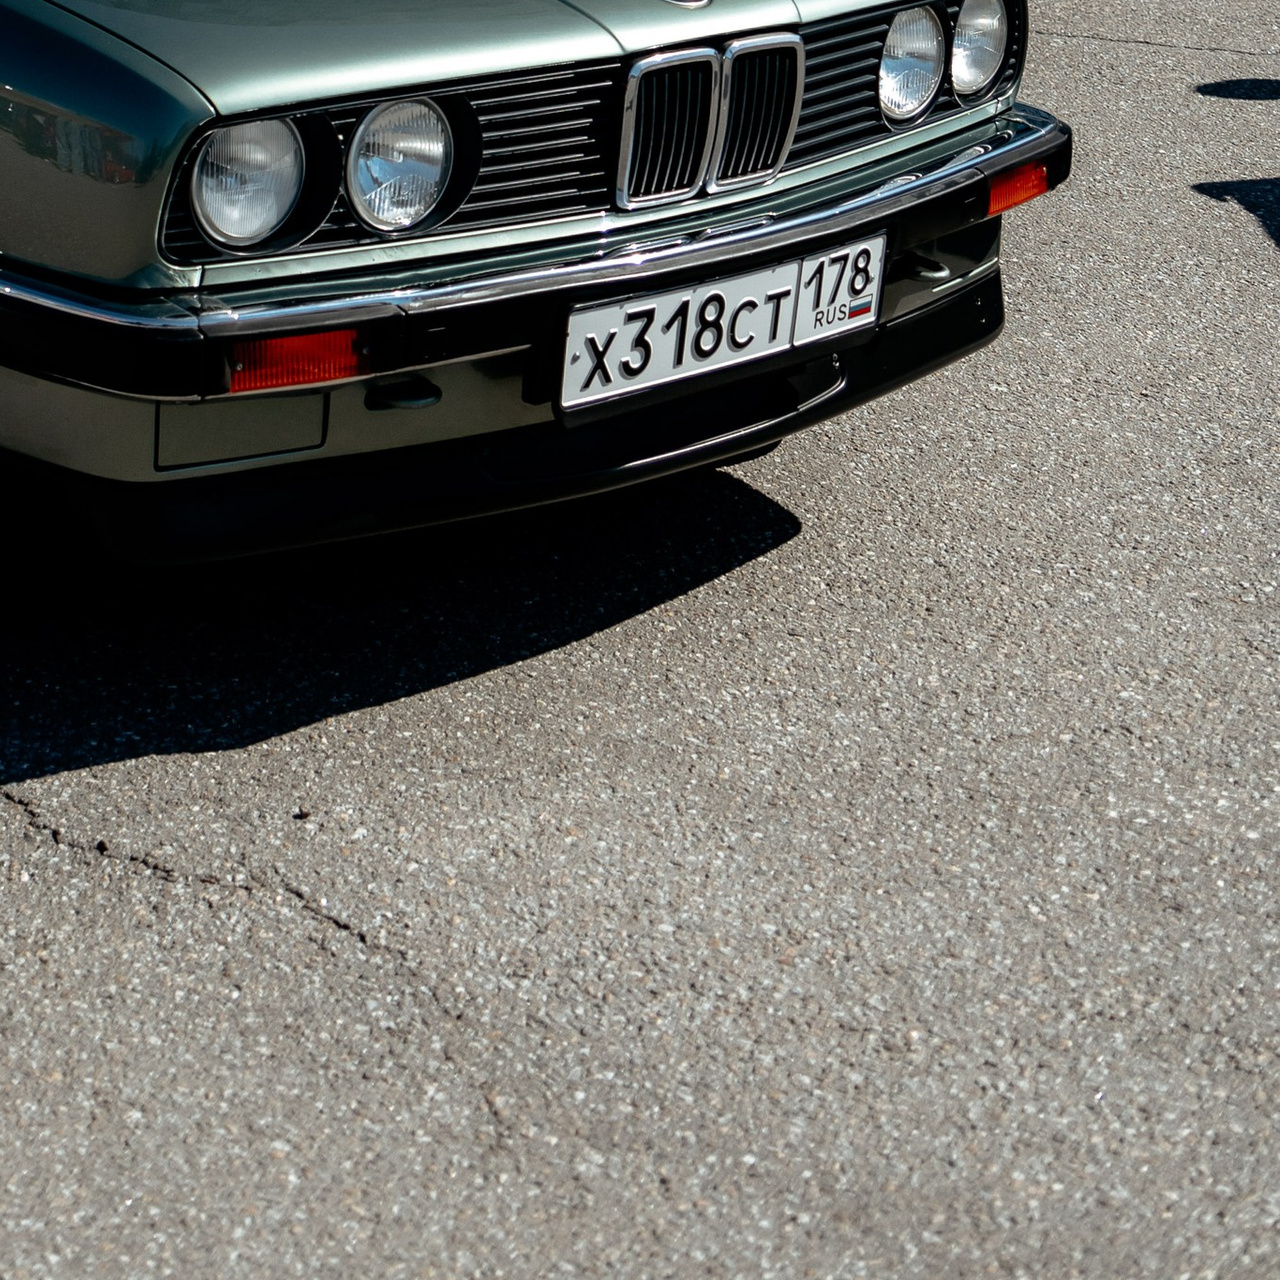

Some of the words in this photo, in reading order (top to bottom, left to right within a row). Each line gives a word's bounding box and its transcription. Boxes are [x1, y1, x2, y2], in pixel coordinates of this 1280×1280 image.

[578, 288, 793, 392] Х318СТ
[803, 246, 872, 312] 178
[813, 302, 848, 330] RUS
